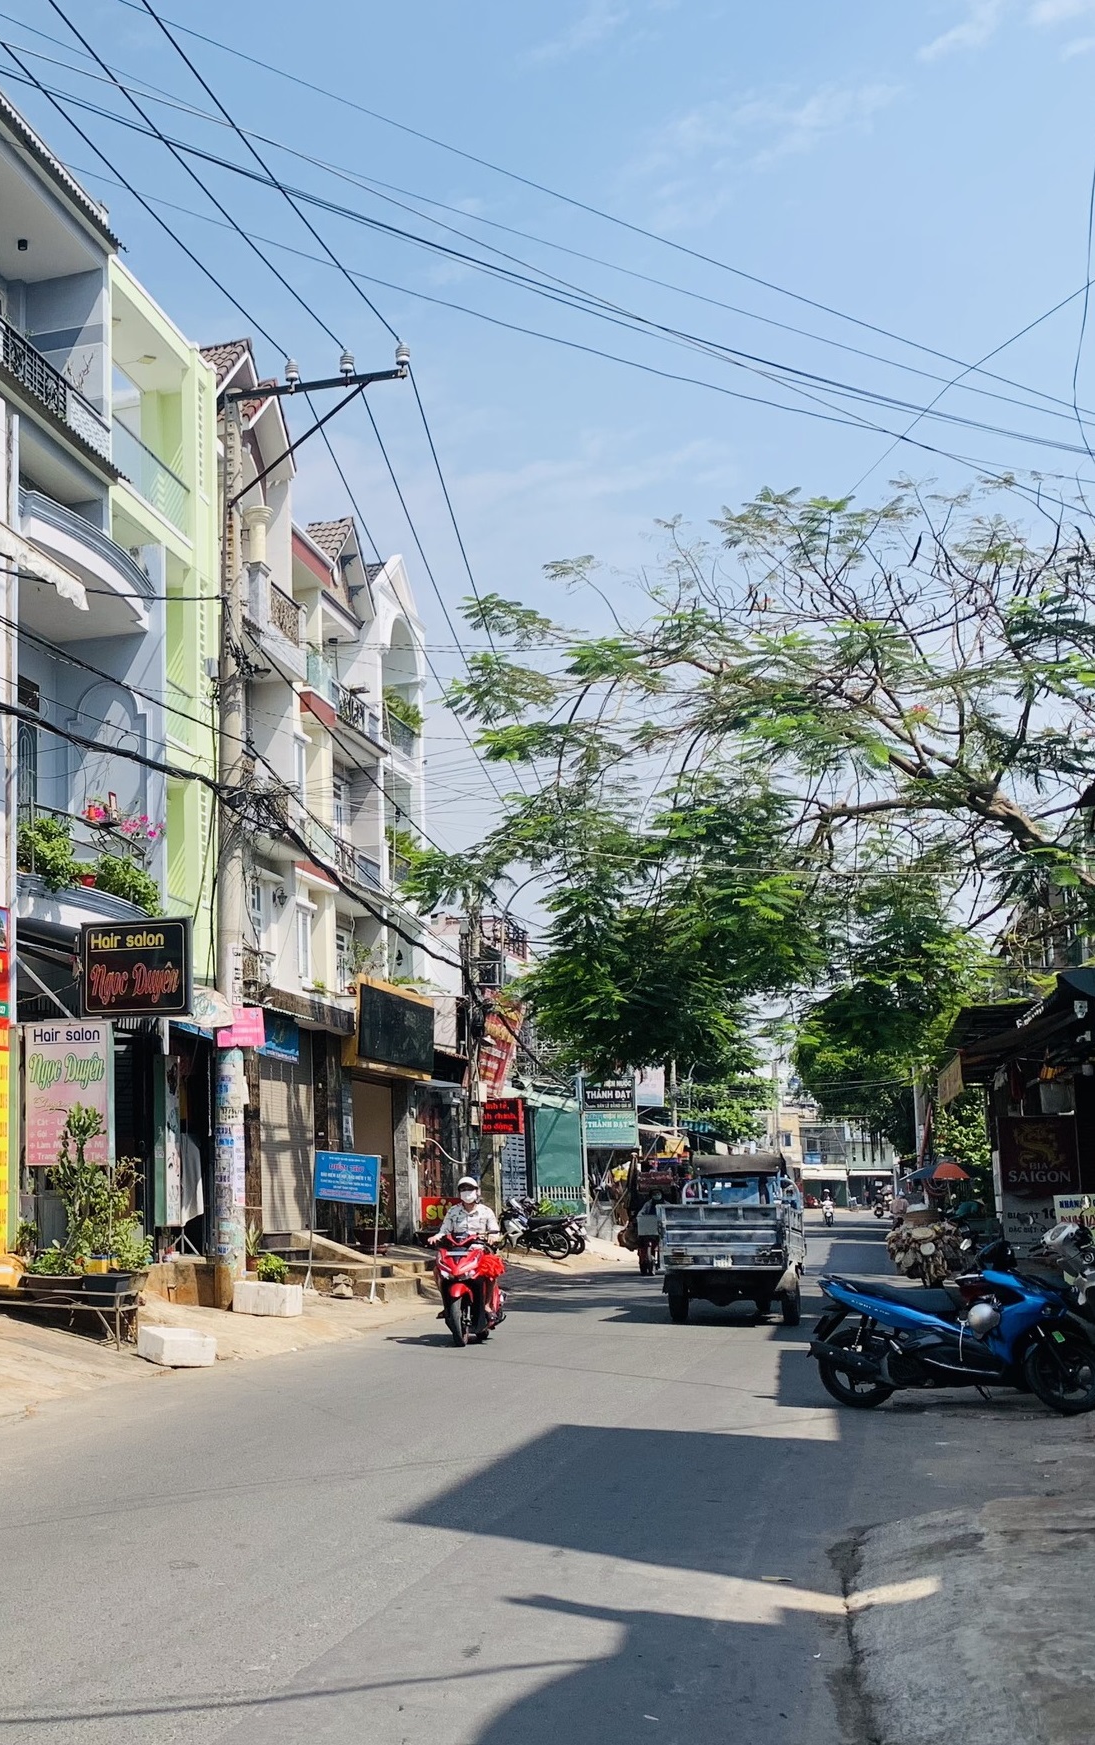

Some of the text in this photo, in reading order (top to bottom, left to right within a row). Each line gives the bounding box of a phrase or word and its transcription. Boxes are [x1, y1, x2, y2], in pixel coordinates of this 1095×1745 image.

[90, 931, 165, 950] Hair salon
[90, 962, 180, 1004] Ngọc Duyên
[33, 1028, 100, 1043] Hair salon
[29, 1052, 62, 1090] Ngọc
[64, 1052, 105, 1090] Duyên
[586, 1089, 631, 1100] THÀNH ĐẠT
[588, 1119, 627, 1129] THÀNH ĐẠT
[1030, 1161, 1049, 1170] BIA
[1008, 1170, 1072, 1183] SAIGON
